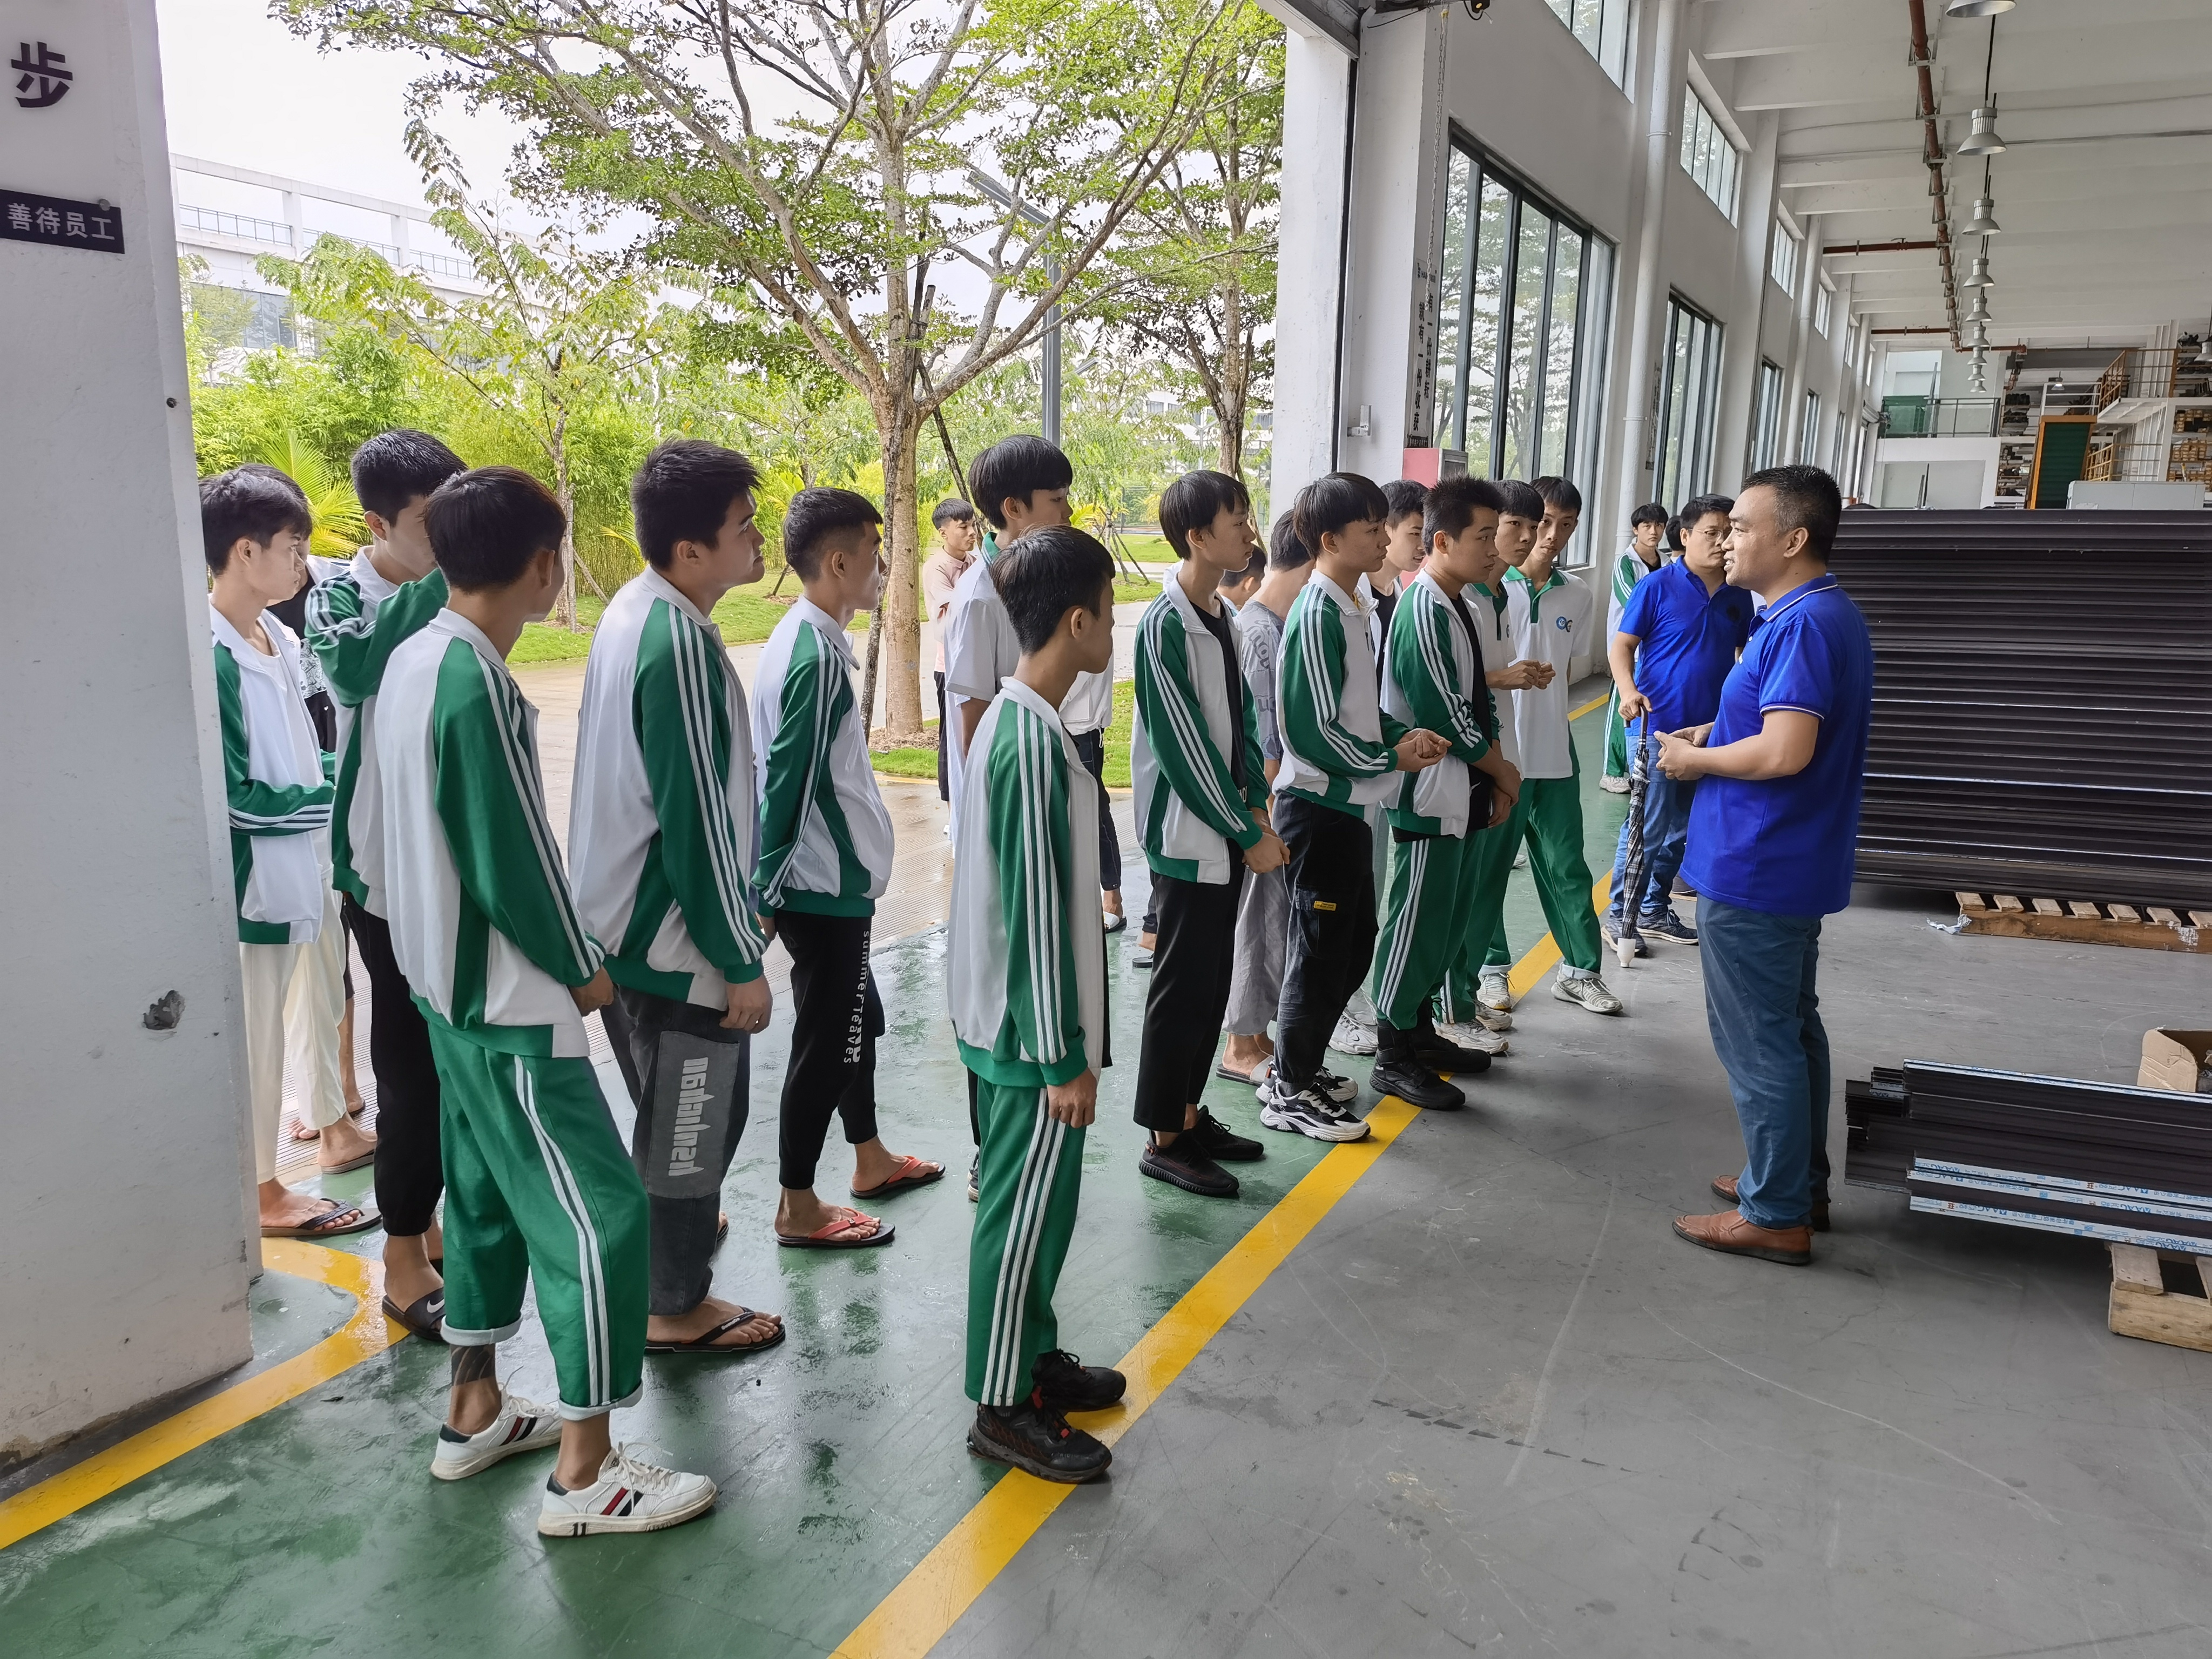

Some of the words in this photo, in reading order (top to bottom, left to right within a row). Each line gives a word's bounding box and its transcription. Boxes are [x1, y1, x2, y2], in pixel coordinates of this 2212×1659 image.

[11, 42, 73, 108] 步
[7, 203, 116, 240] 善待员工
[856, 930, 869, 1004] summer
